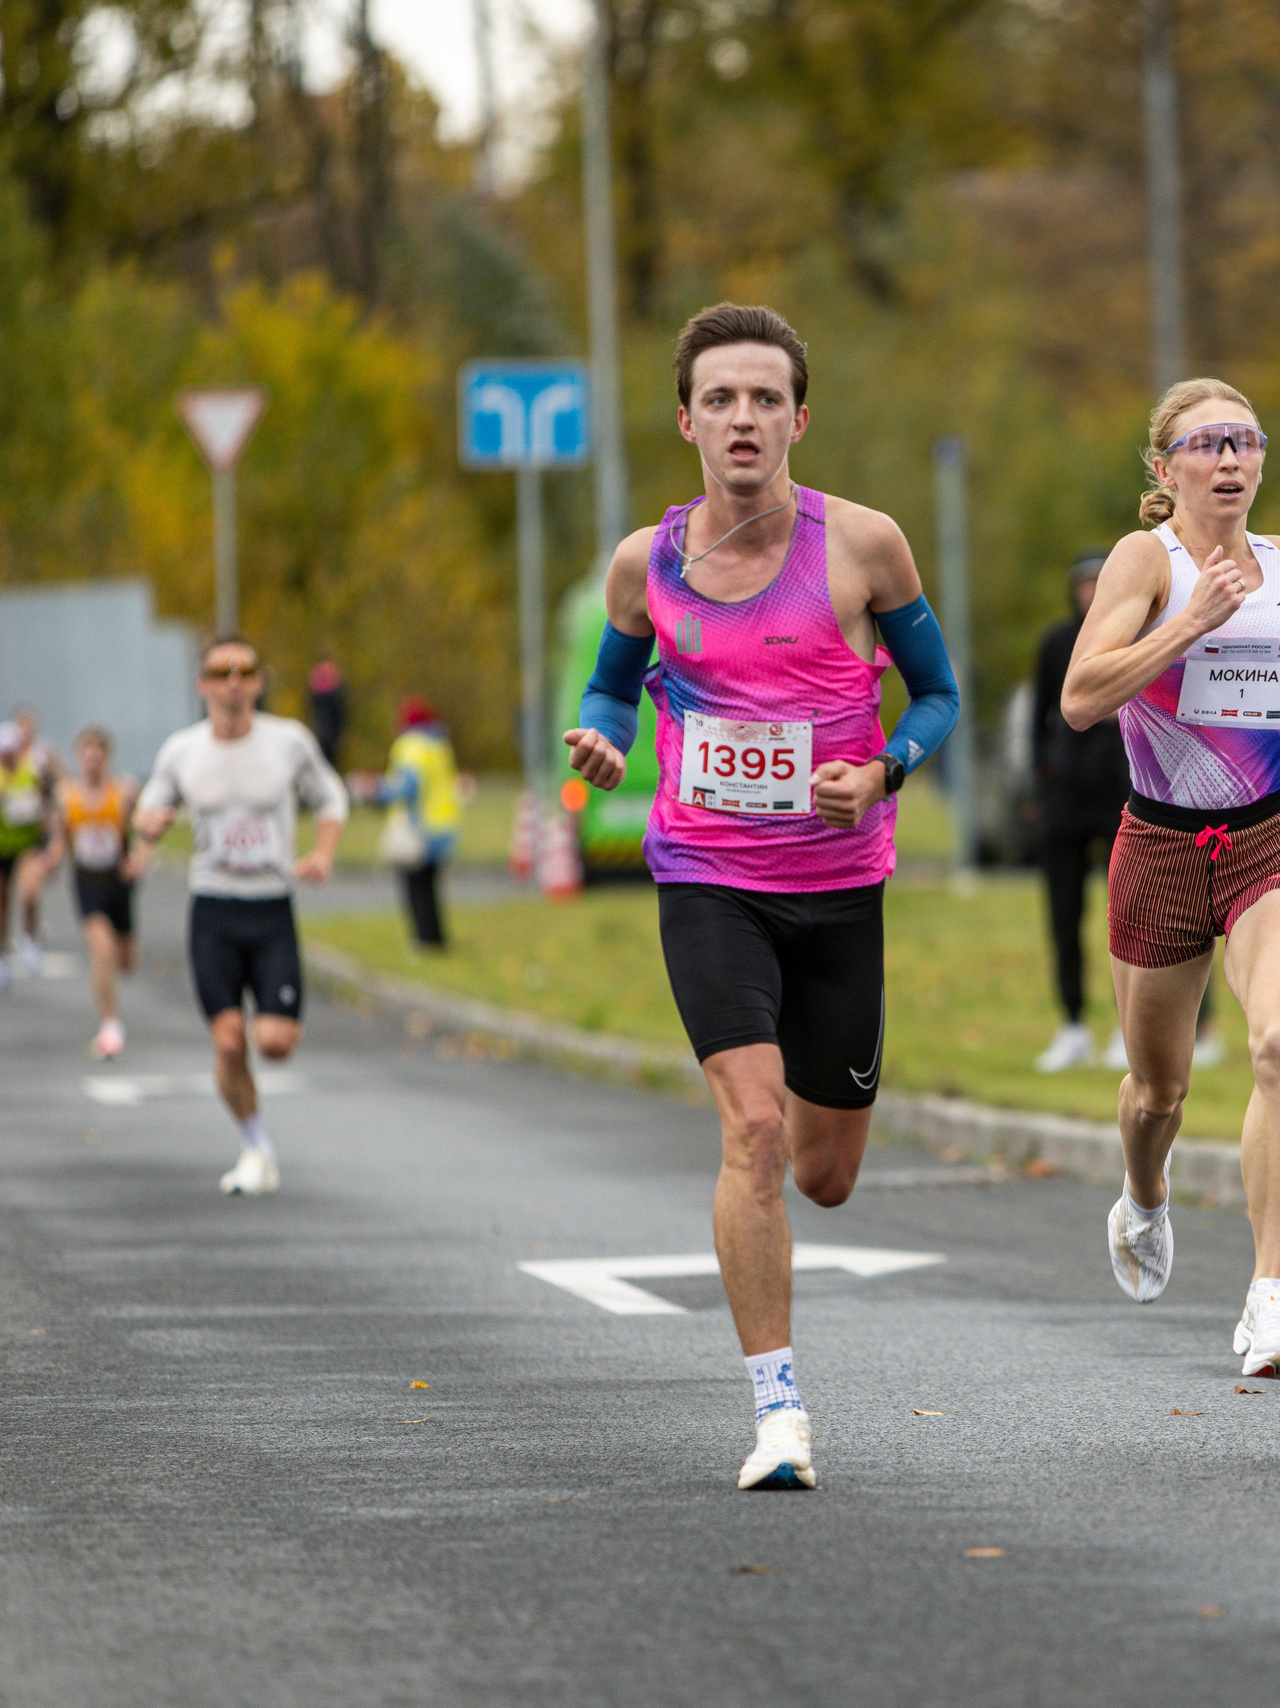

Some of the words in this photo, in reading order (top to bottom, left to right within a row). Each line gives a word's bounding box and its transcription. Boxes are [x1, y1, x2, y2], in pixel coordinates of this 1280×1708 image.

[1209, 669, 1279, 682] МОКИНА
[1239, 688, 1244, 698] 1
[695, 719, 704, 727] 10
[698, 741, 795, 780] 1395
[719, 780, 768, 790] КОНСТАНТИН
